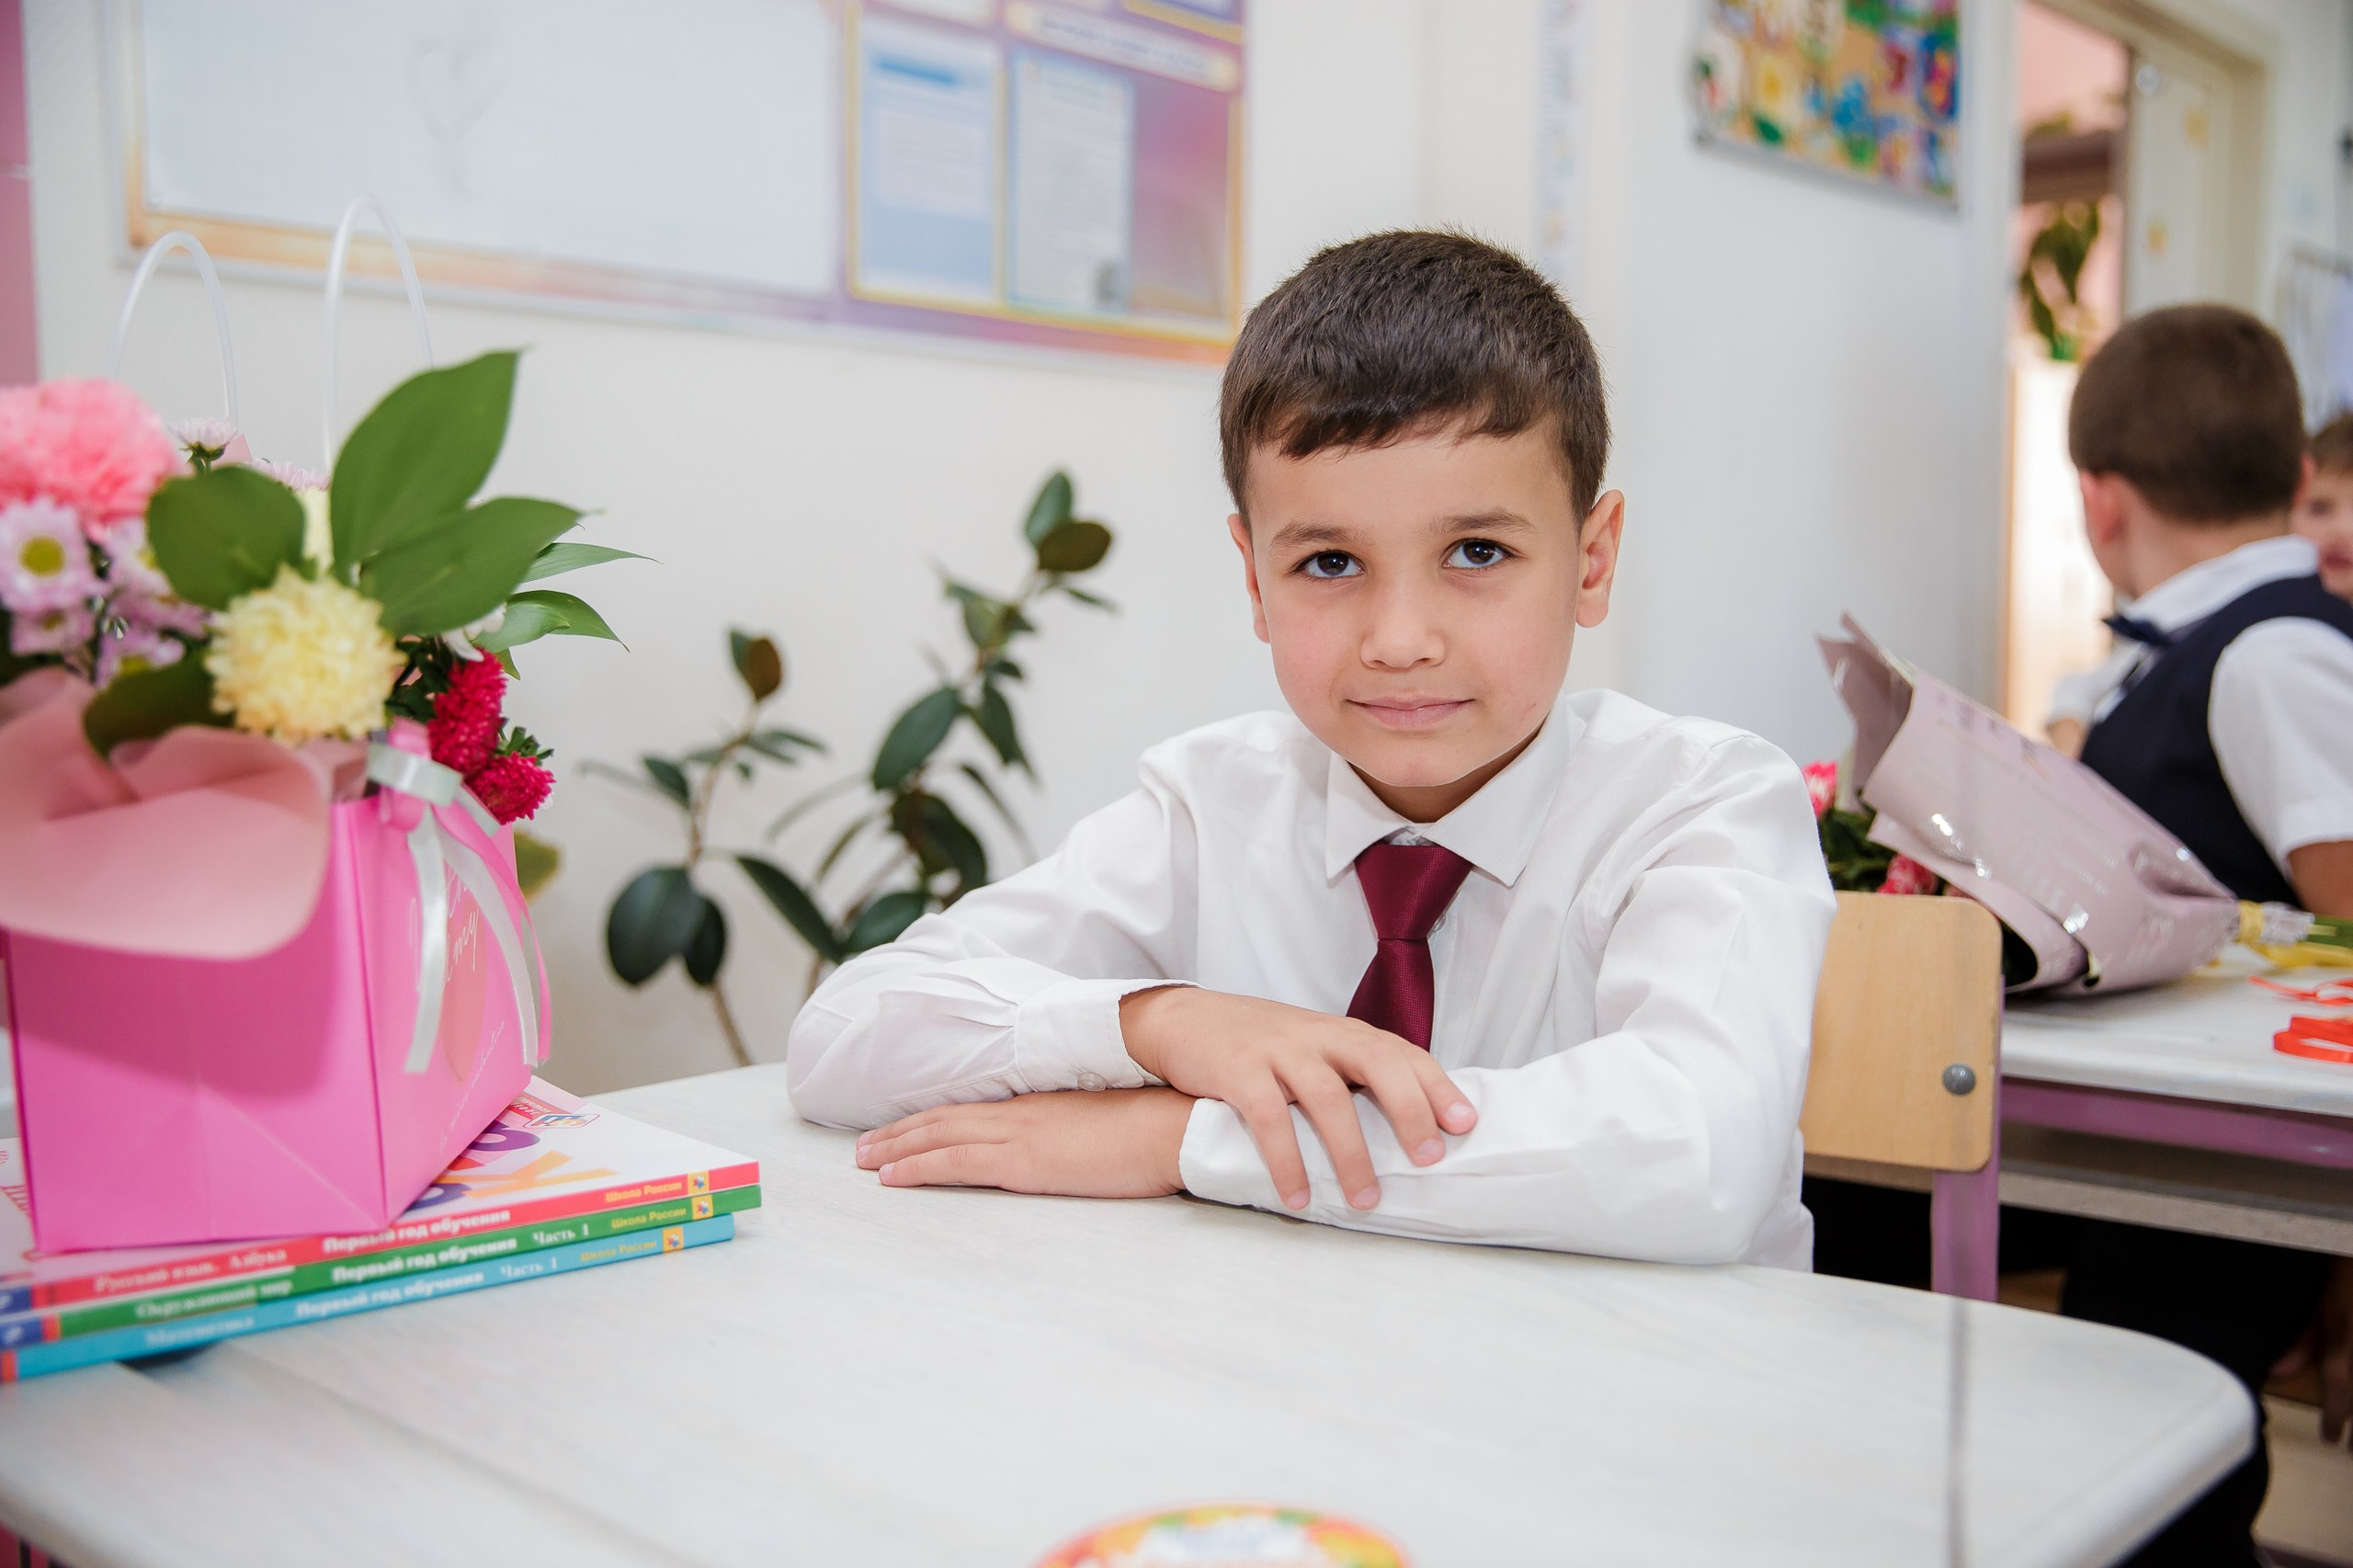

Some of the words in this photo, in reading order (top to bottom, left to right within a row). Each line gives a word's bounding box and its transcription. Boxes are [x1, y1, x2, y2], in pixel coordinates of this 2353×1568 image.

[231, 1249, 288, 1268] Азбука
[324, 1229, 396, 1253] Первый
[398, 1222, 429, 1241] год
[430, 1210, 511, 1237] обучения
[605, 1188, 642, 1203] Школа
[644, 1181, 683, 1196] России
[260, 1280, 292, 1298] мир
[332, 1255, 404, 1283] Первый
[406, 1252, 437, 1269] год
[438, 1238, 517, 1266] обучения
[533, 1228, 576, 1246] Часть
[582, 1223, 590, 1237] 1
[611, 1215, 647, 1230] Школа
[649, 1207, 687, 1221] России
[295, 1291, 369, 1318] Первый
[371, 1287, 401, 1303] год
[404, 1271, 483, 1296] обучения
[501, 1262, 544, 1278] Часть
[580, 1248, 617, 1262] Школа
[619, 1241, 657, 1255] России
